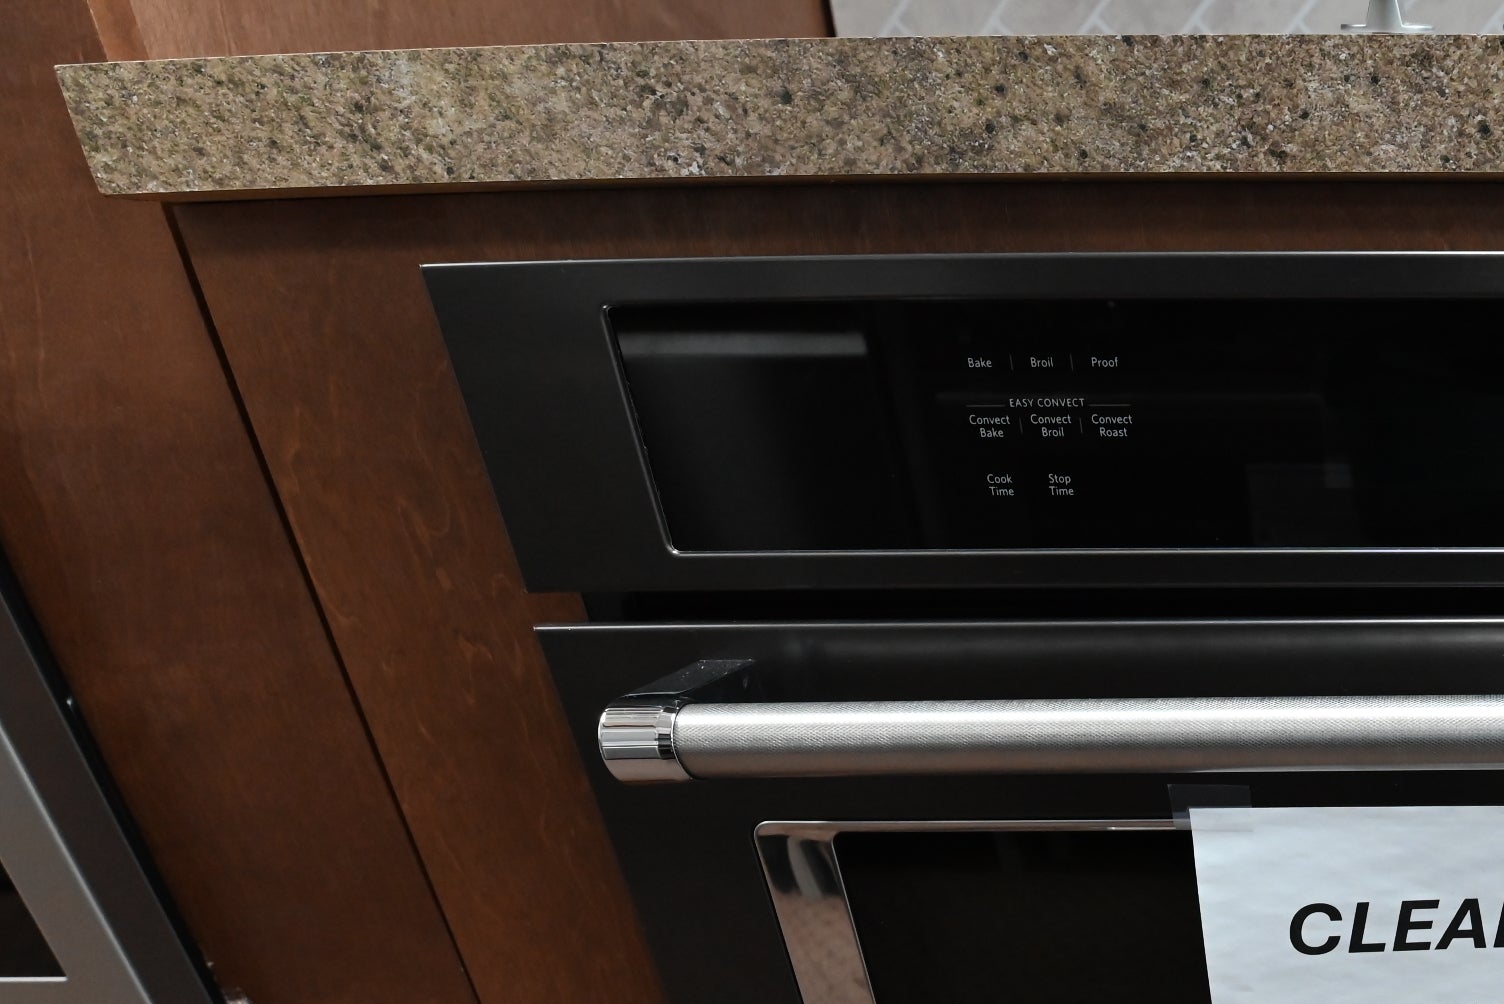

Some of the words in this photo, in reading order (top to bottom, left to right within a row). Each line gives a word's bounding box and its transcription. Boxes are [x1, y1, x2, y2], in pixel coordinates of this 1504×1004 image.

[967, 357, 993, 368] Bake
[1029, 356, 1054, 368] Broil
[1091, 356, 1119, 368] Proof
[1009, 398, 1034, 408] EASY
[1037, 397, 1085, 408] CONVECT
[968, 414, 1011, 425] Convect
[1030, 413, 1072, 425] Convect
[1091, 413, 1133, 425] Convect
[979, 427, 1004, 438] Bake
[1041, 426, 1065, 437] Broil
[1099, 426, 1128, 437] Roast
[986, 473, 1013, 484] Cook
[1048, 473, 1072, 486] Stop
[988, 486, 1015, 496] Time
[1048, 486, 1074, 496] Time
